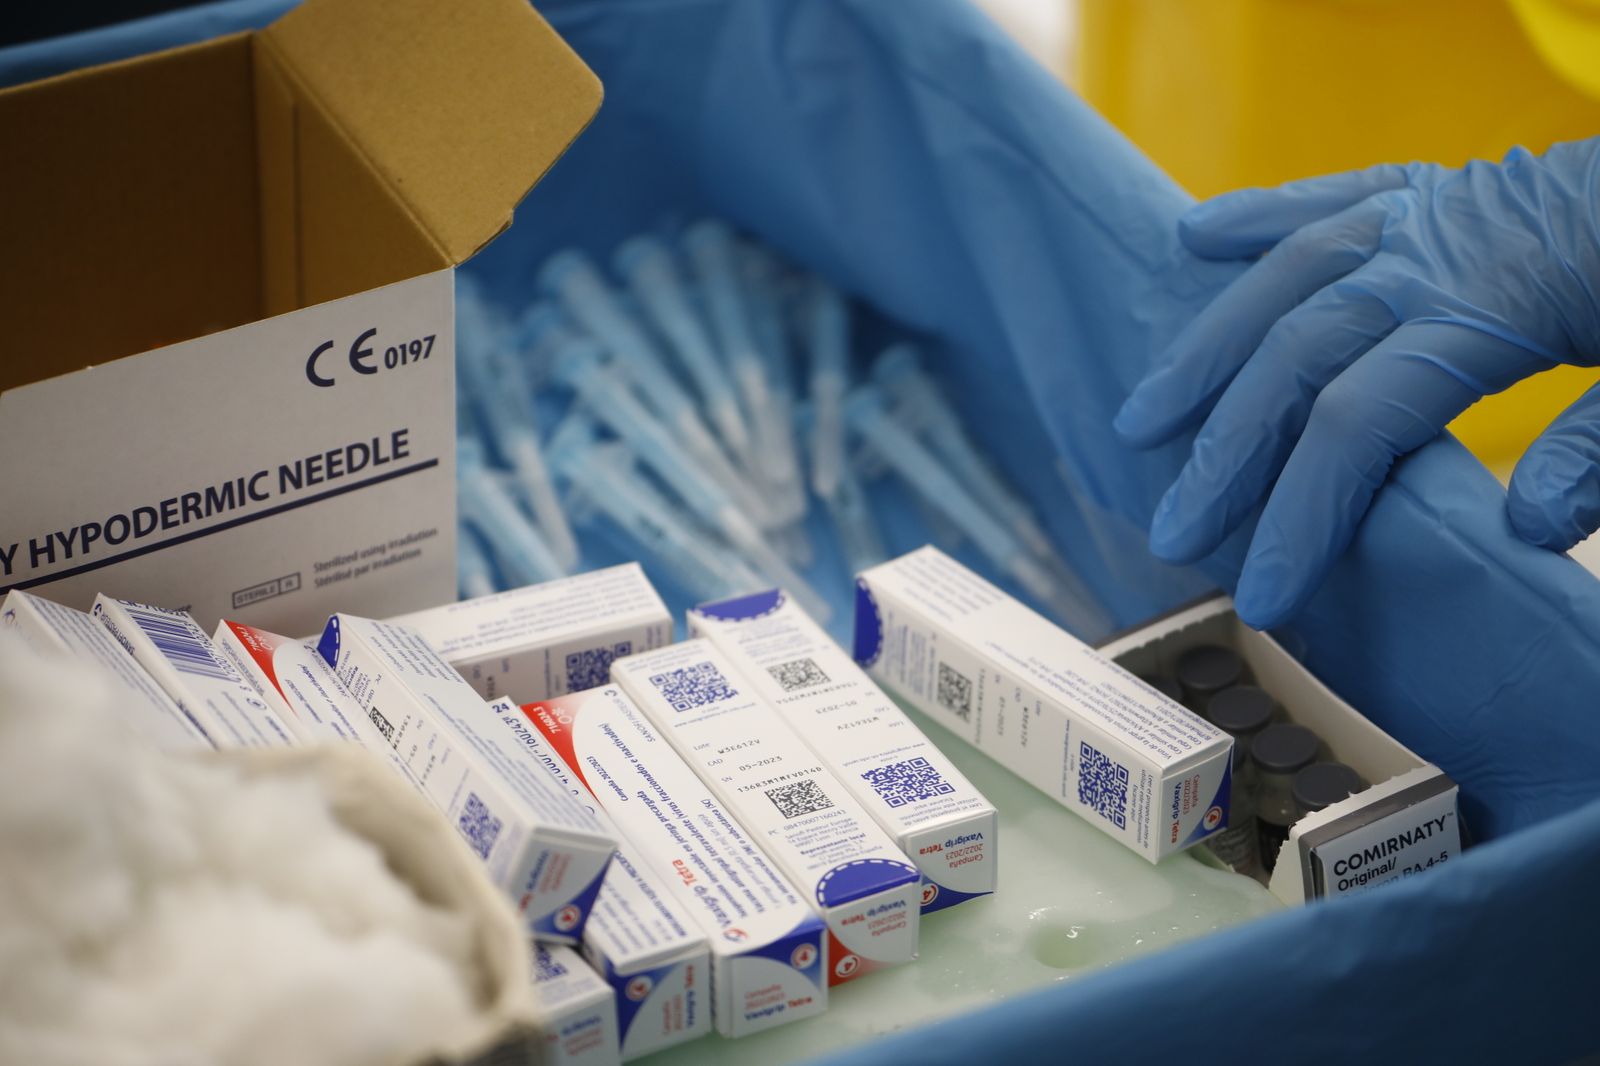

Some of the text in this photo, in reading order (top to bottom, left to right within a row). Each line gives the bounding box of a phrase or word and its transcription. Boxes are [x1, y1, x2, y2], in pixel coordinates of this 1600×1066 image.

[384, 334, 436, 369] 0197
[29, 470, 270, 568] HYPODERMIC
[278, 428, 410, 494] NEEDLE
[313, 550, 358, 573] Sterilized
[738, 756, 782, 771] 05-2023
[608, 780, 629, 802] Campaña
[635, 763, 671, 802] fraccionados
[637, 790, 669, 823] precargada
[1171, 782, 1182, 843] Vaxigrip Tetra
[664, 823, 688, 844] jeringa
[682, 820, 718, 857] tetravalente
[712, 809, 741, 839] subcutánea
[919, 832, 983, 855] Vaxigrip Tetra
[945, 843, 983, 860] 2022/2023
[949, 853, 983, 868] Campaña
[1337, 856, 1397, 892] Original/
[672, 859, 731, 927] Vaxigrip Tetra
[841, 900, 906, 925] Vaxigrip Tetra
